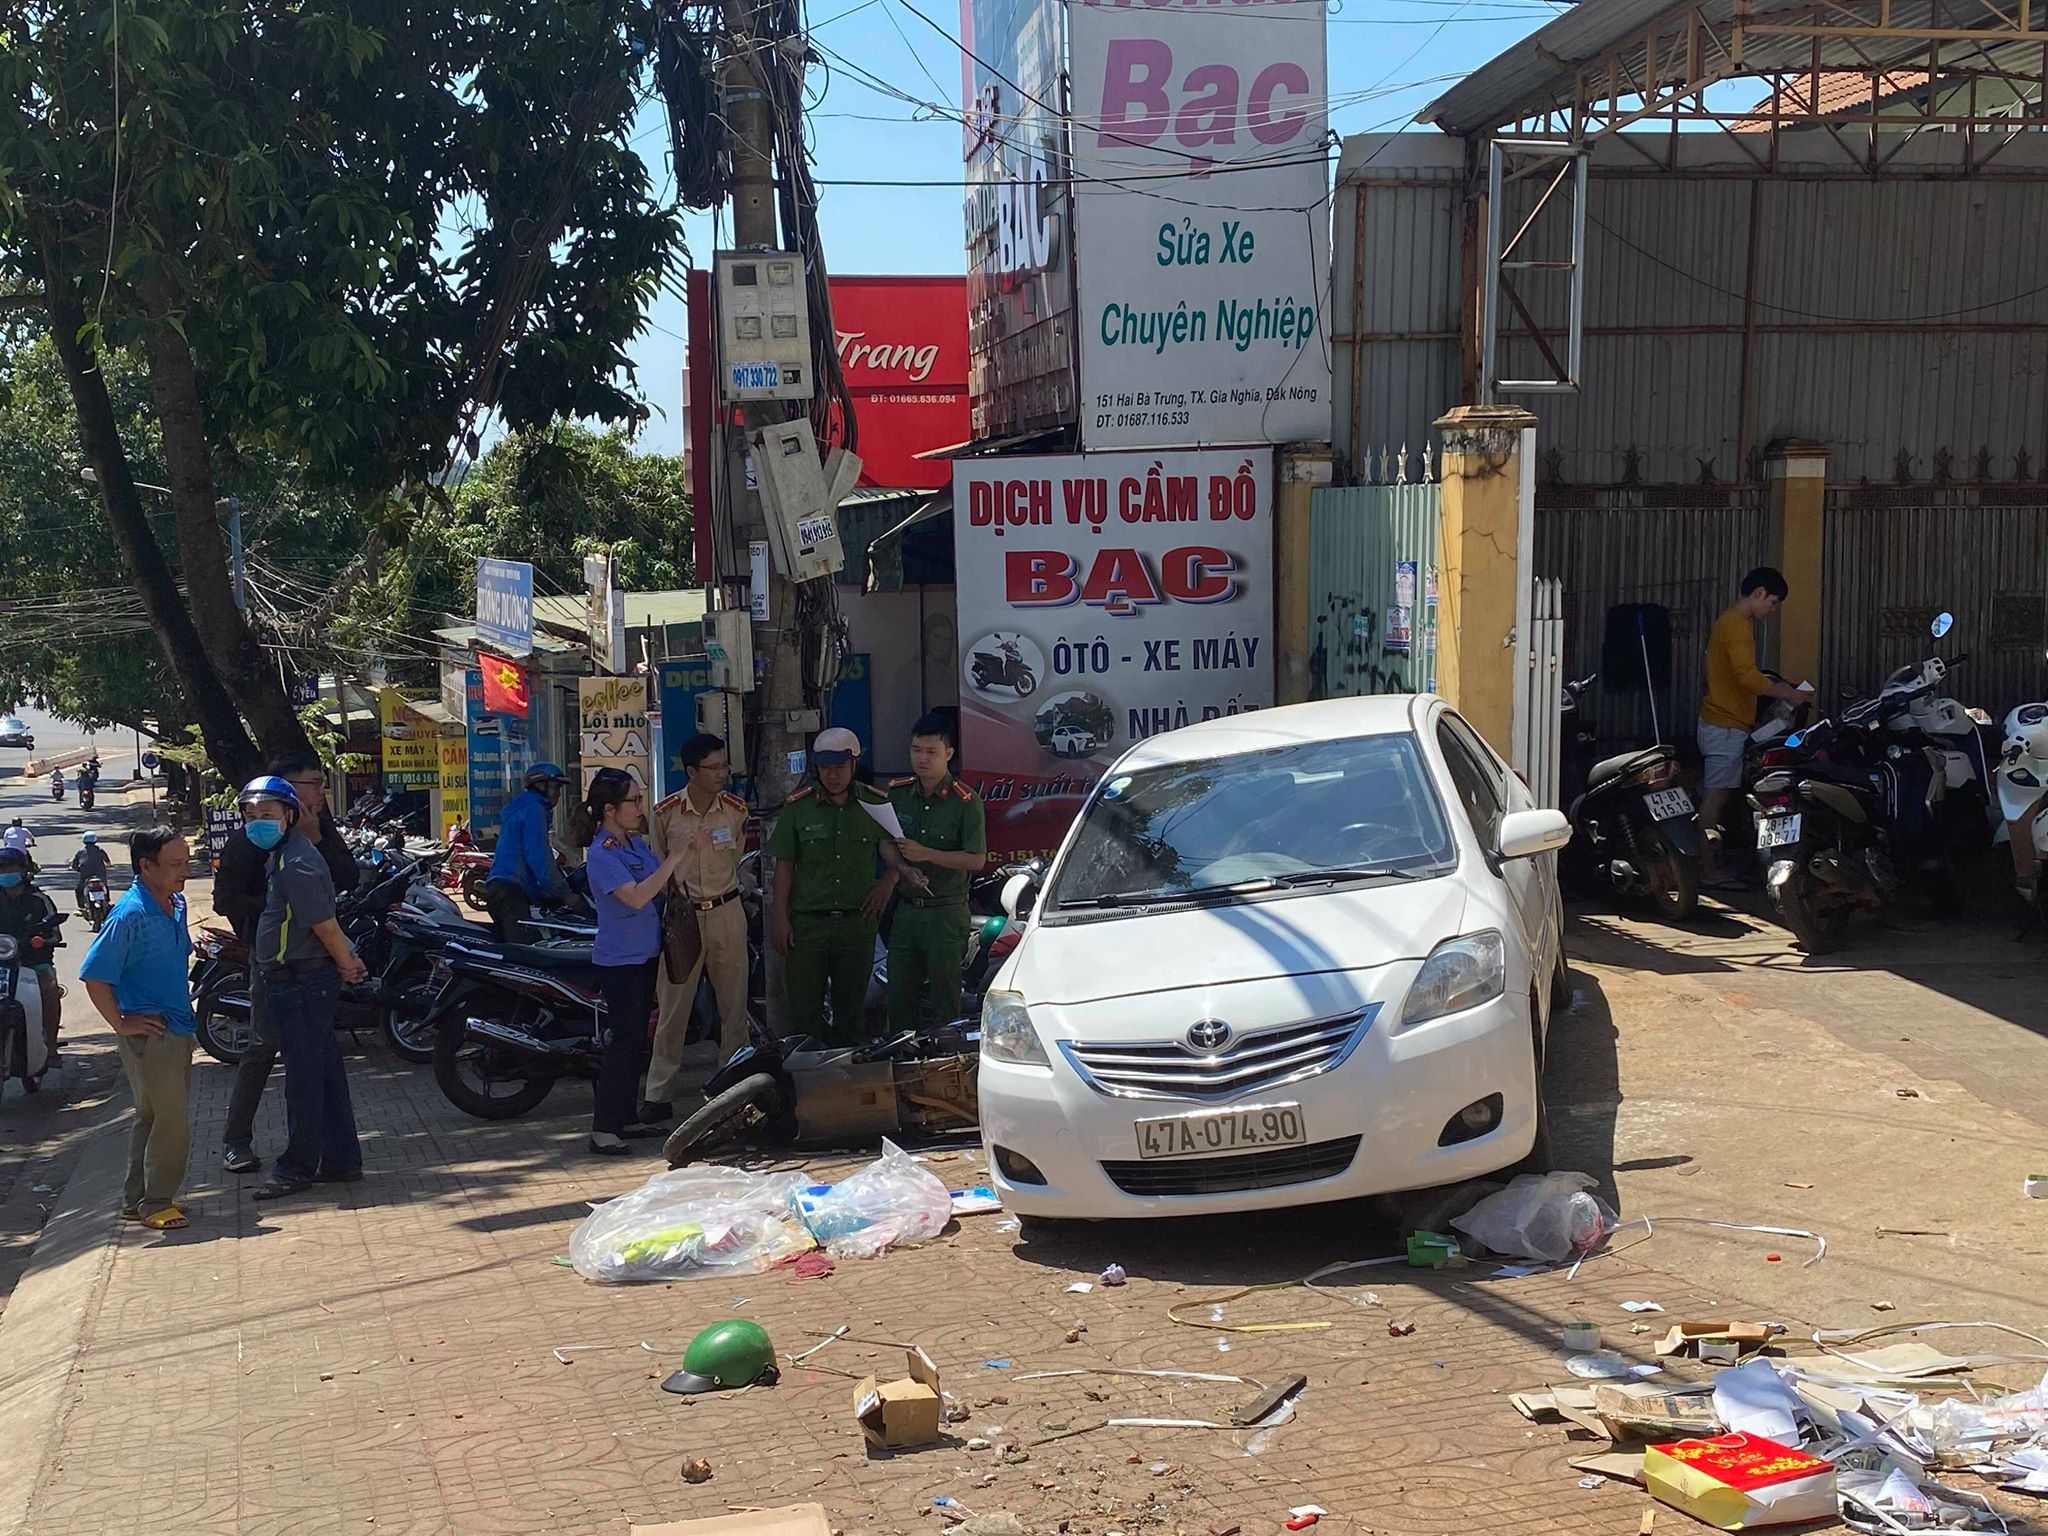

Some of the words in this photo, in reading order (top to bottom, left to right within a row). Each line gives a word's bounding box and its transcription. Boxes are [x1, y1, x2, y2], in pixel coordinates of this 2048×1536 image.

[1097, 38, 1310, 180] Bạc
[1157, 216, 1210, 267] Sửa
[1219, 220, 1255, 264] Xe
[1101, 303, 1207, 355] Chuyên
[1216, 297, 1314, 352] Nghiệp
[835, 330, 940, 382] Trang
[871, 394, 887, 403] ĐT:
[1096, 394, 1113, 408] 151
[1116, 392, 1134, 407] Hai
[1136, 391, 1150, 406] Bà
[1191, 391, 1207, 404] TX.
[1210, 390, 1227, 404] Gia
[1096, 414, 1115, 428] ĐT:
[1117, 411, 1190, 428] 01687.116.533
[970, 480, 1052, 537] DỊCH
[1062, 478, 1107, 534] VỤ
[1119, 460, 1198, 525] CẦM
[1208, 458, 1257, 522] ĐỒ
[1004, 545, 1239, 617] BẠC
[1052, 635, 1111, 676] ÔTÔ
[1143, 639, 1181, 672] XE
[1192, 632, 1260, 670] MÁY
[1129, 699, 1189, 740] NHÀ
[390, 745, 401, 756] XE
[405, 742, 425, 756] MÁY
[976, 778, 1015, 802] Lãi
[1019, 771, 1076, 800] suất
[1650, 790, 1681, 805] 47-B1
[1653, 800, 1691, 818] 415.19
[210, 823, 228, 832] MUA
[1760, 829, 1797, 847] 036.77
[1008, 850, 1034, 863] 151
[1144, 1110, 1299, 1154] 47A-074.90
